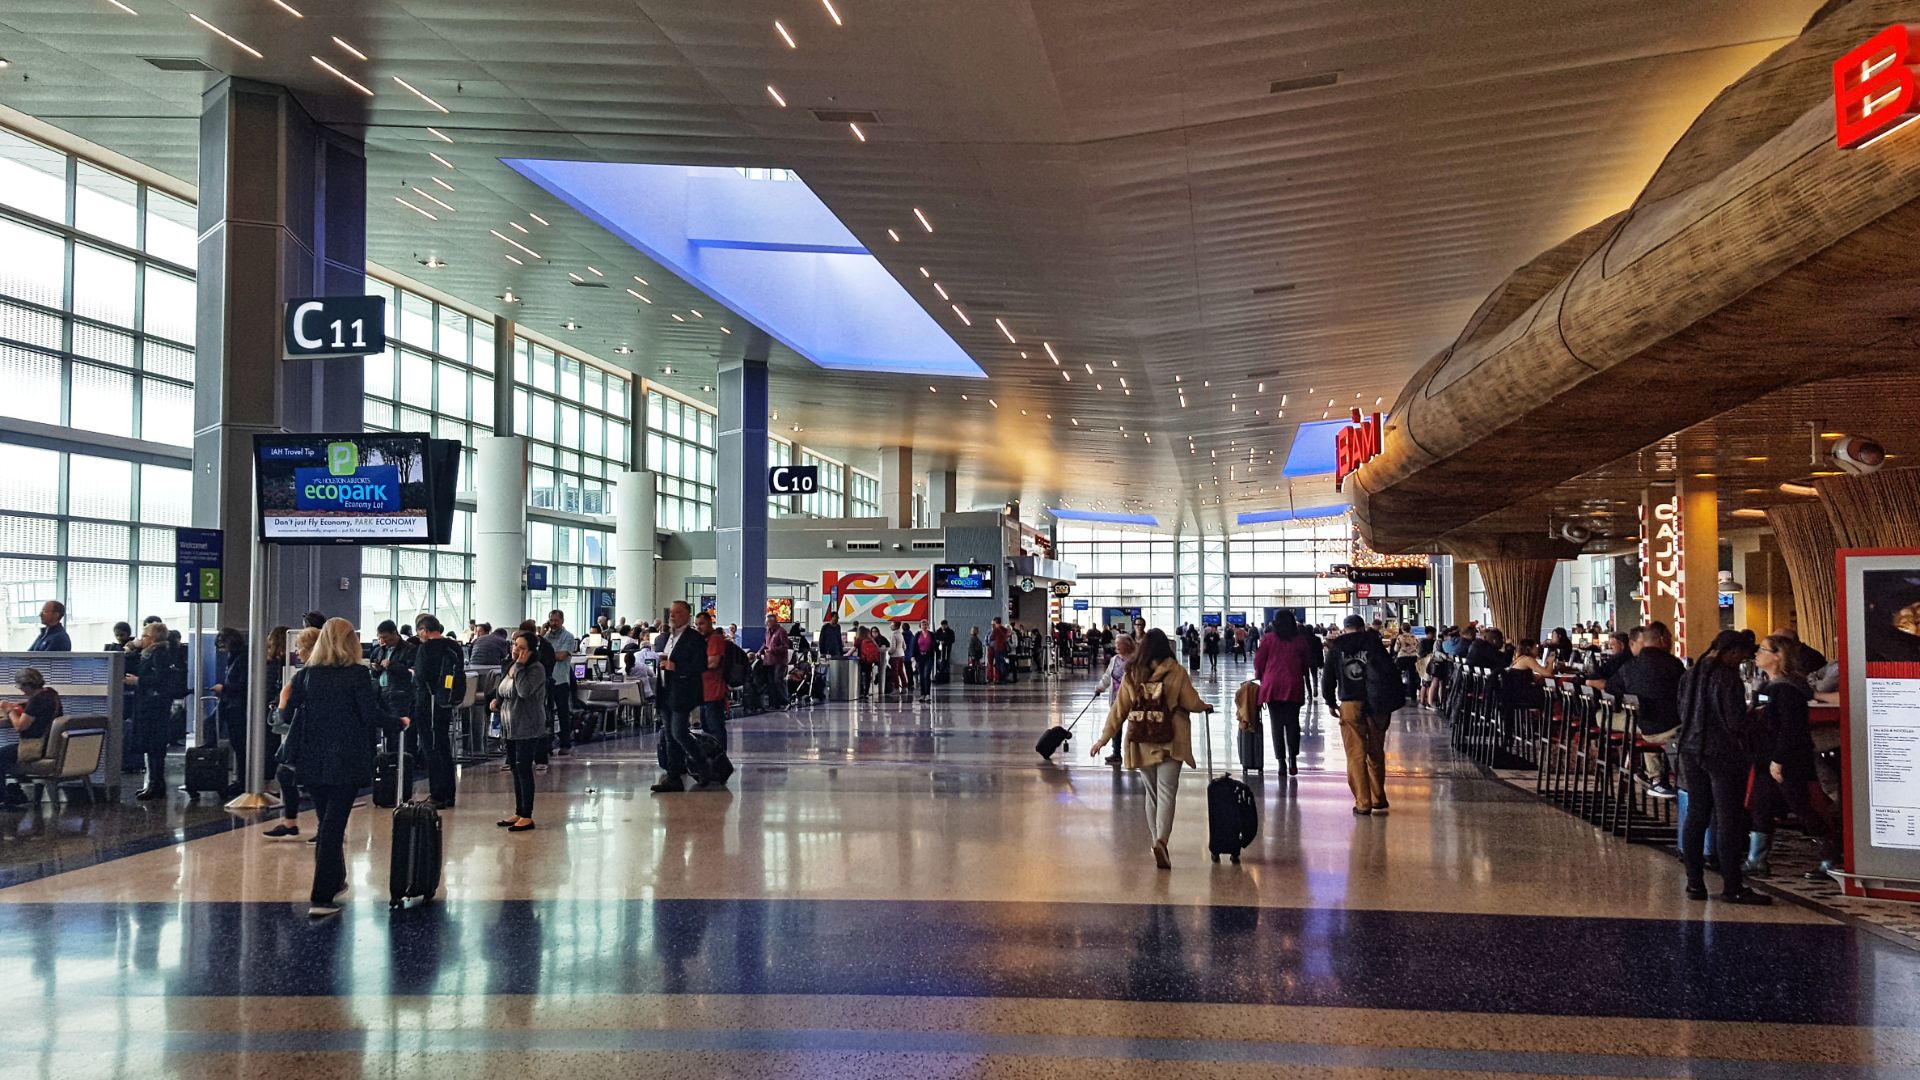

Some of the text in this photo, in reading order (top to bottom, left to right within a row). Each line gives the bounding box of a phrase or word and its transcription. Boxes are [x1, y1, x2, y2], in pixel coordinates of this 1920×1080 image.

[293, 301, 367, 349] C11
[284, 447, 304, 456] Travel
[304, 447, 315, 457] Tip
[773, 467, 813, 491] C10
[304, 484, 389, 504] ecopark
[344, 501, 384, 510] Economy Lot
[274, 518, 293, 526] Don't
[294, 518, 307, 528] just
[308, 518, 319, 528] Fly
[355, 518, 373, 526] PARK
[375, 518, 417, 526] ECONOMY
[1655, 503, 1676, 597] CAJUN
[184, 572, 193, 586] 1
[205, 572, 214, 586] 2
[950, 579, 979, 587] ecopark
